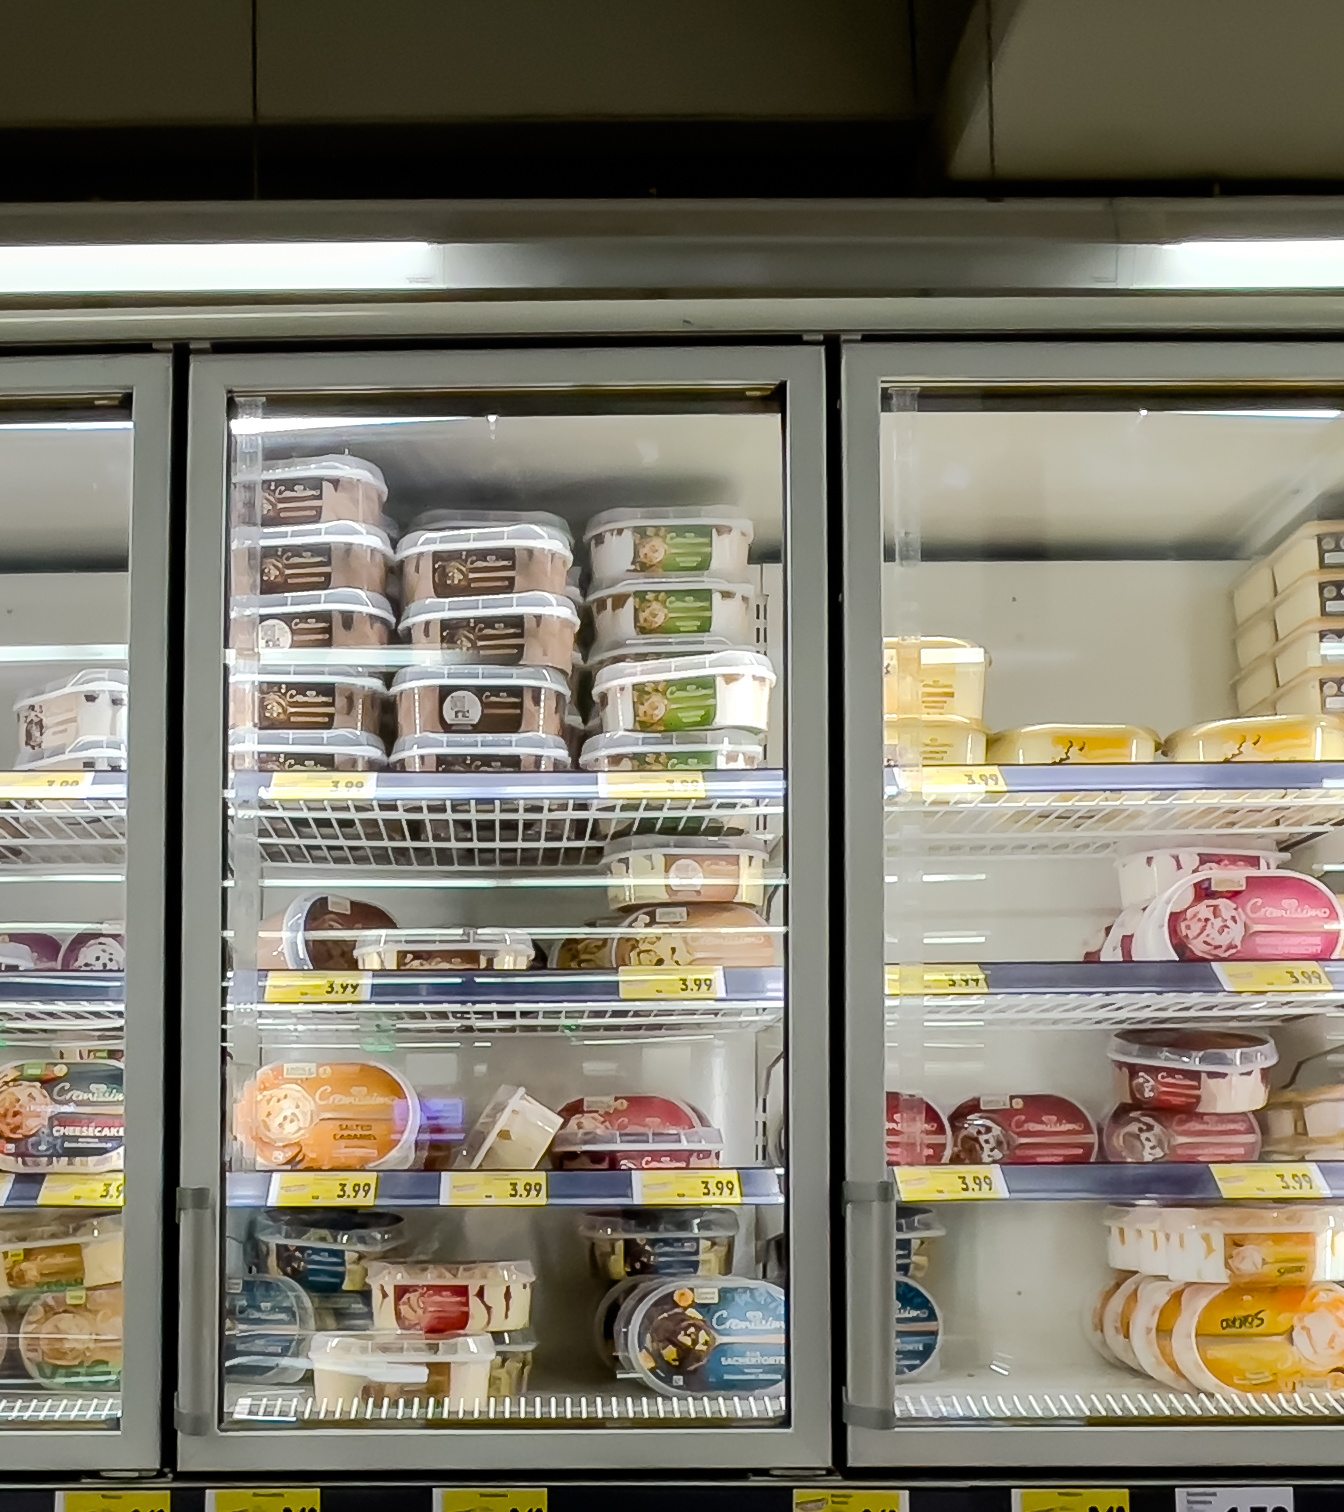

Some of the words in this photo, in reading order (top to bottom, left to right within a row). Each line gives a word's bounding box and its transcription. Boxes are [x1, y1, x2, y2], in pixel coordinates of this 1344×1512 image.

[679, 978, 714, 993] 3.99
[1286, 970, 1323, 985] 3.99
[700, 1179, 735, 1196] 3.99
[957, 1175, 994, 1192] 3.99
[1275, 1173, 1315, 1190] 3.99
[100, 1183, 124, 1199] 3.9
[336, 1182, 372, 1199] 3.99
[508, 1182, 544, 1198] 3.99
